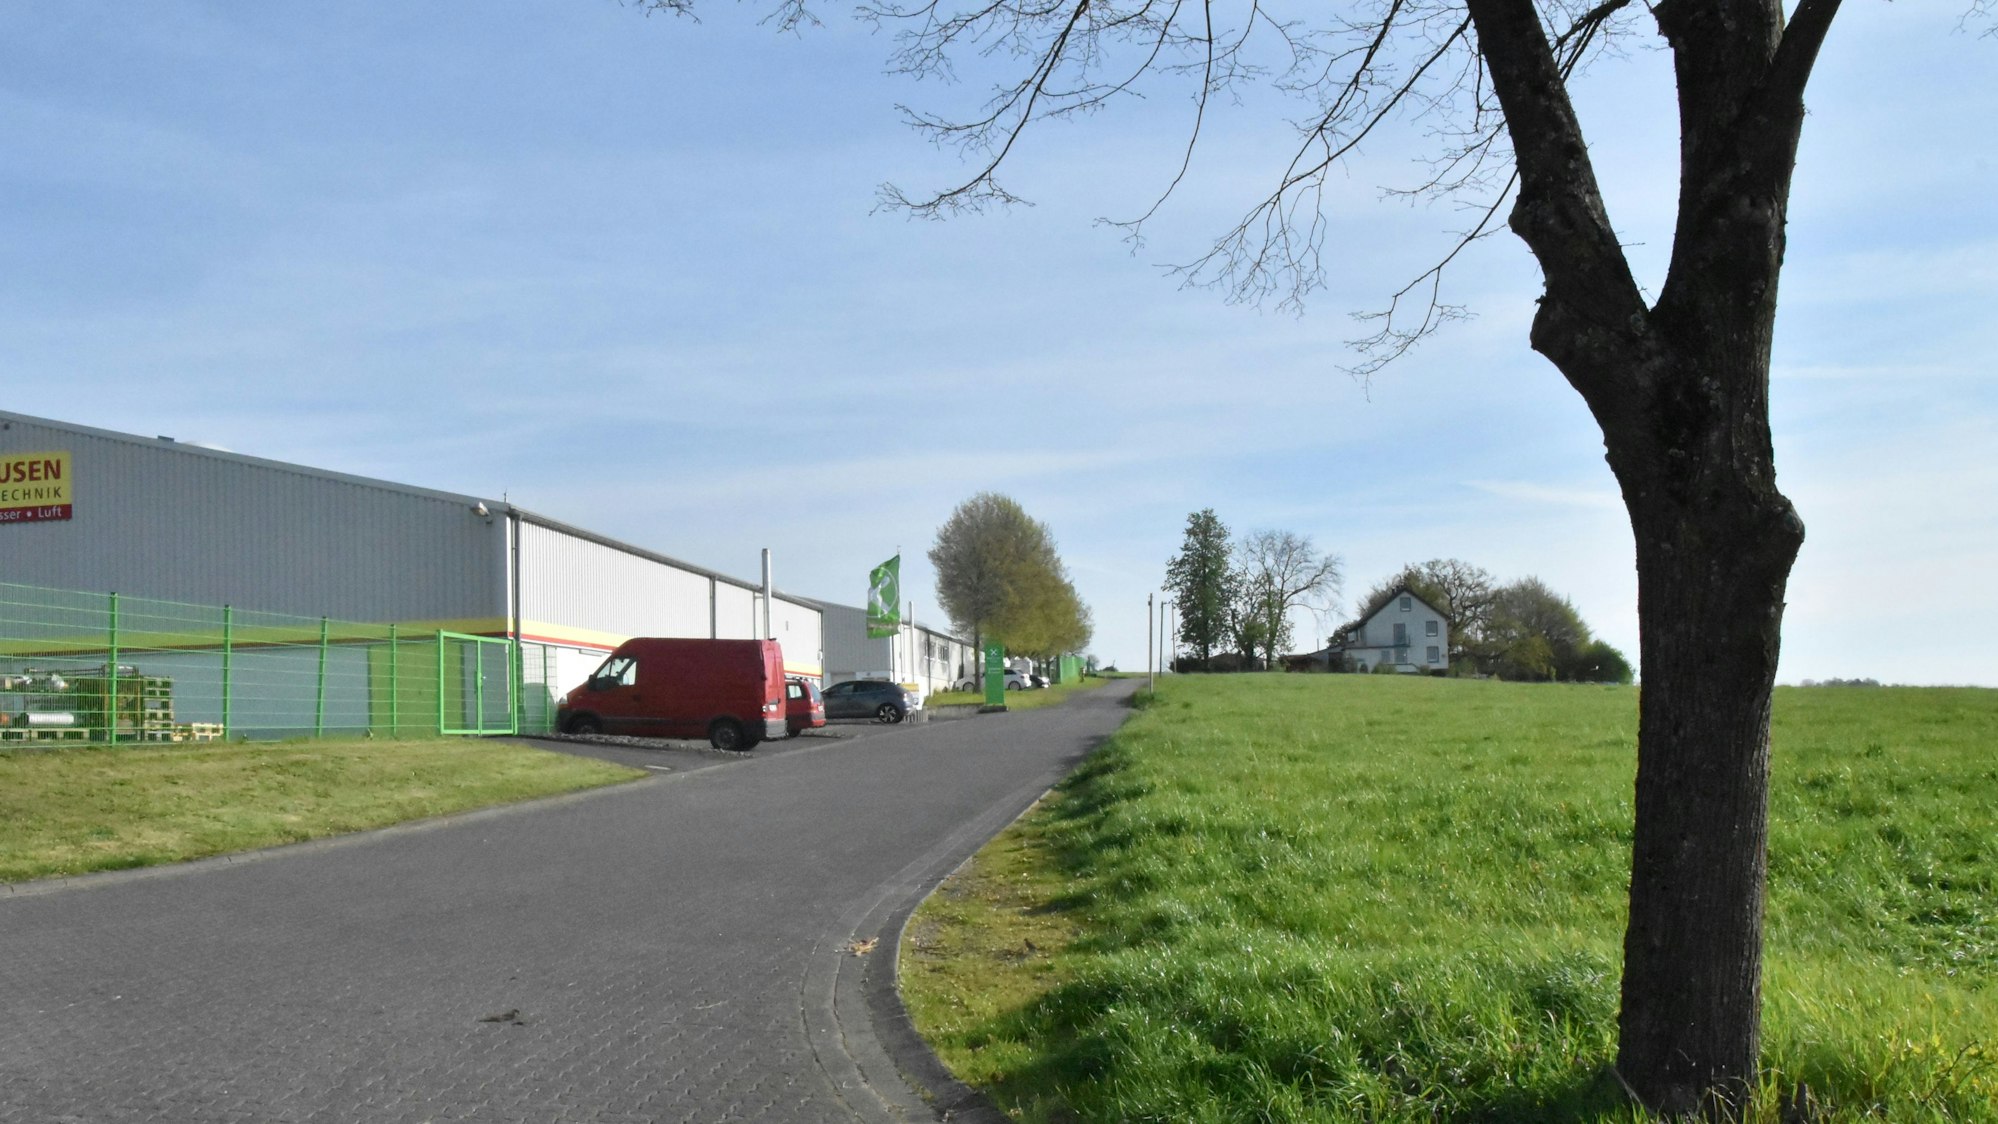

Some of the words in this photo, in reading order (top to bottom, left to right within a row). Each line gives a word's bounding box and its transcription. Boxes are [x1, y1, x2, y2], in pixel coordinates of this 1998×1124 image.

[0, 459, 61, 484] USEN
[2, 487, 62, 501] ECHNIK
[38, 505, 62, 518] Luft
